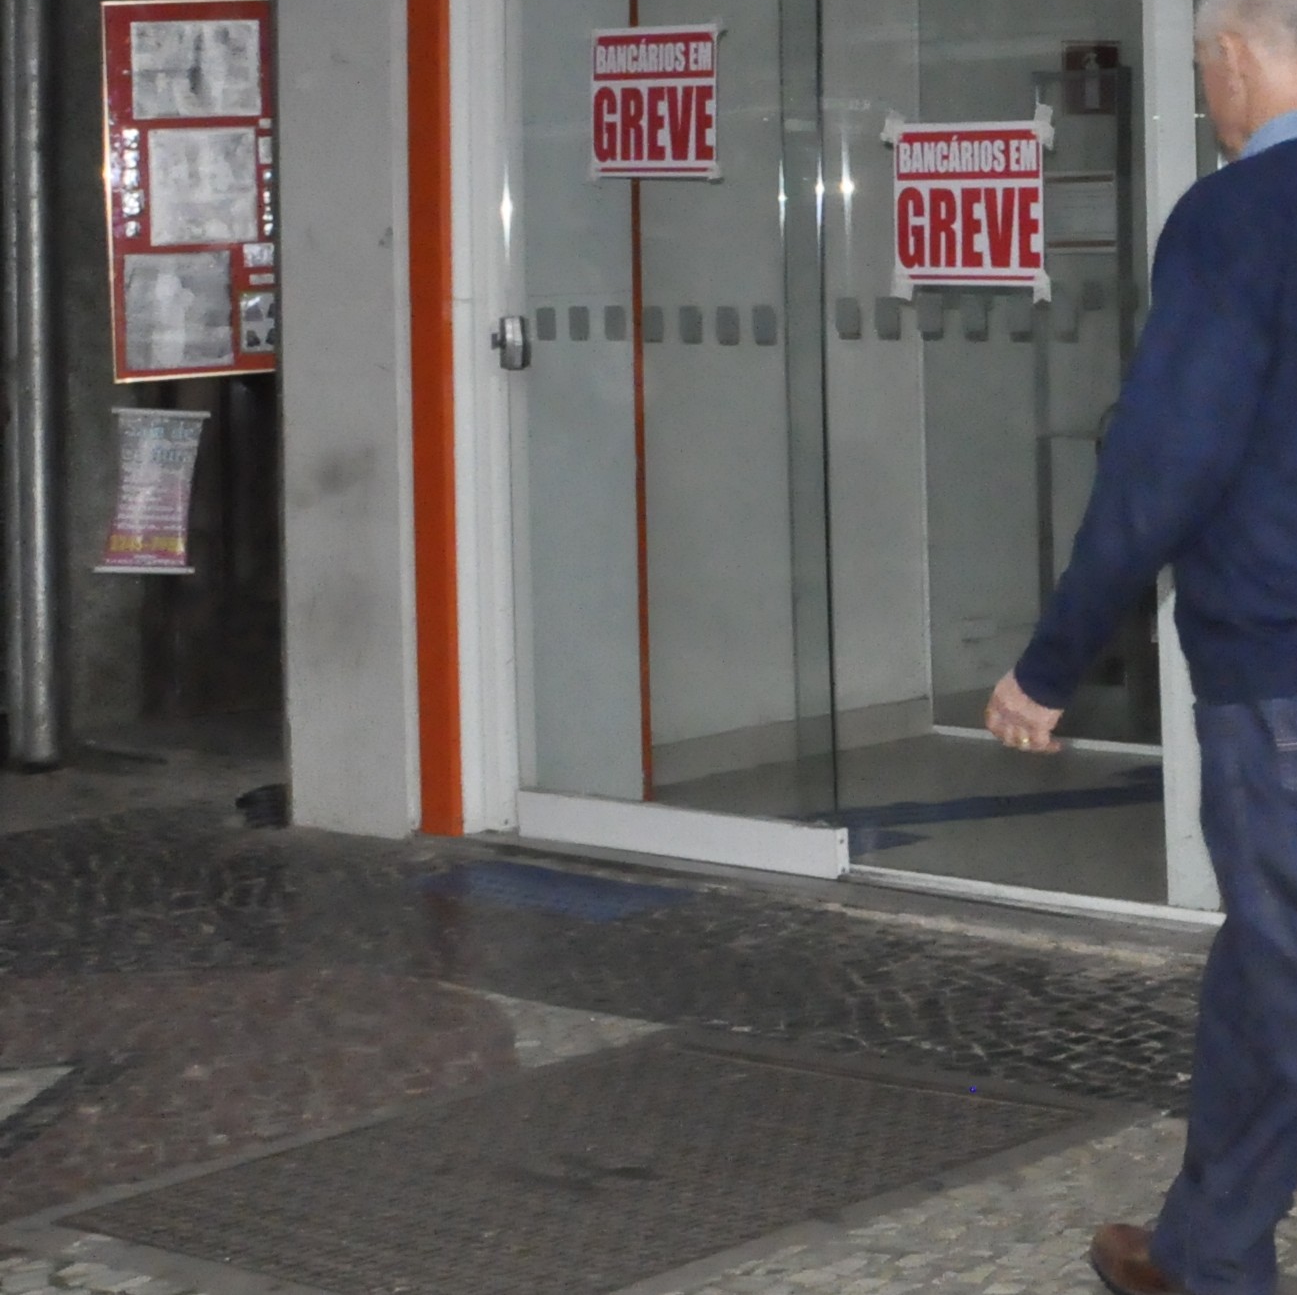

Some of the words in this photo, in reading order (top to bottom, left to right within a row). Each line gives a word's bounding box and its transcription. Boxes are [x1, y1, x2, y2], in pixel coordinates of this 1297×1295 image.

[596, 36, 687, 75] BANCÁRIOS
[689, 39, 713, 72] EM
[593, 85, 714, 163] GREVE
[899, 135, 1006, 173] BANCÁRIOS
[1009, 139, 1037, 172] EM
[897, 187, 1041, 269] GREVE
